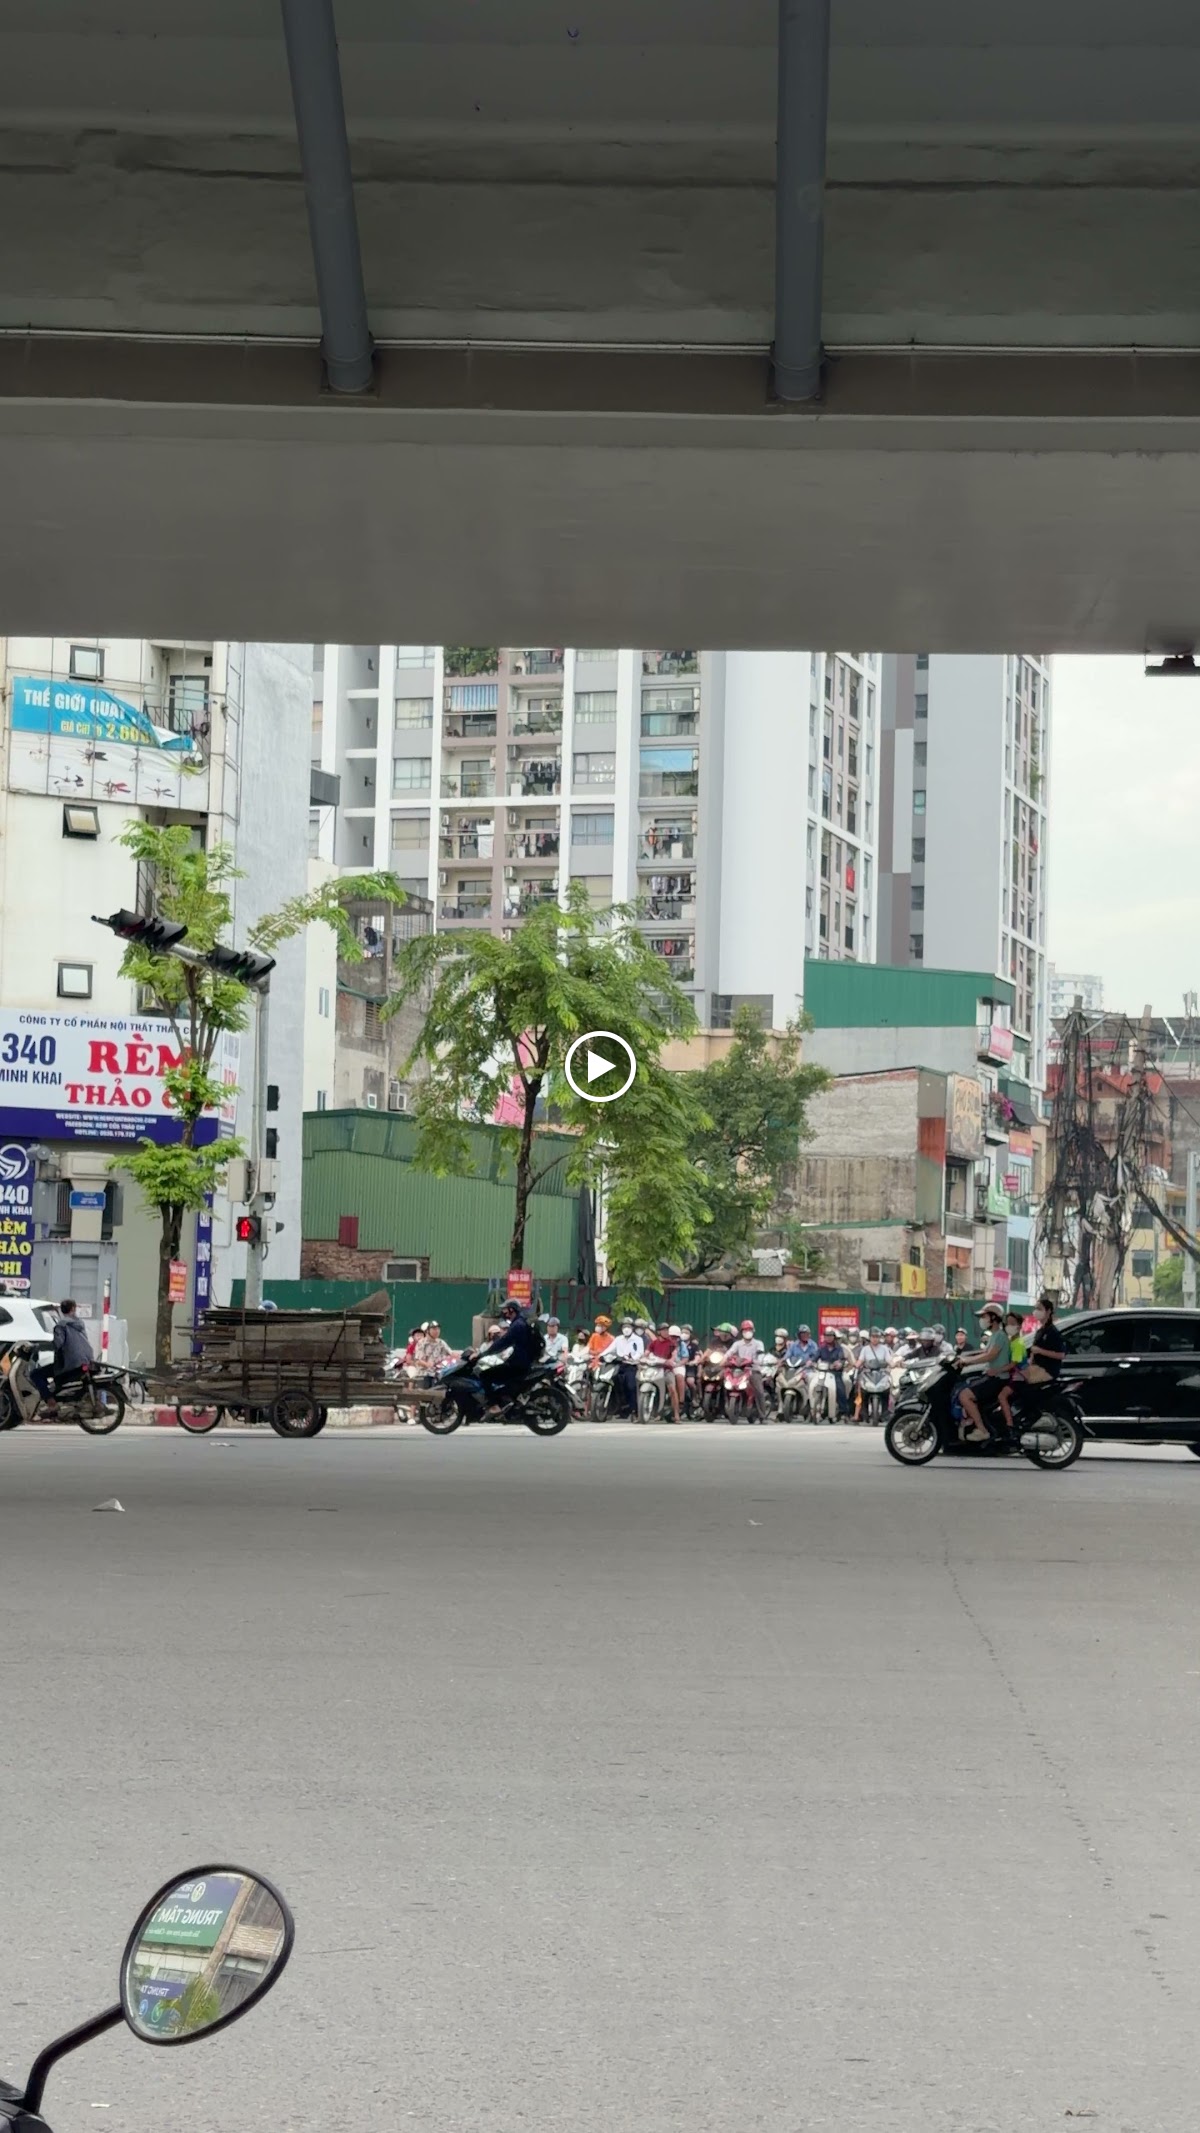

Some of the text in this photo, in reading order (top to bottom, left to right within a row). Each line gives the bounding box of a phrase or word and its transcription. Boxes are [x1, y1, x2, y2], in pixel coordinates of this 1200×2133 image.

[19, 1014, 47, 1026] CÔNG
[49, 1017, 61, 1026] TY
[110, 1021, 127, 1032] NỘI
[130, 1021, 154, 1033] THẤT
[2, 1033, 57, 1066] 340
[87, 1033, 192, 1077] RÈM
[32, 1071, 62, 1085] KHAI
[64, 1077, 152, 1108] THẢO
[0, 1217, 27, 1236] ÈM
[0, 1236, 32, 1256] HẢO
